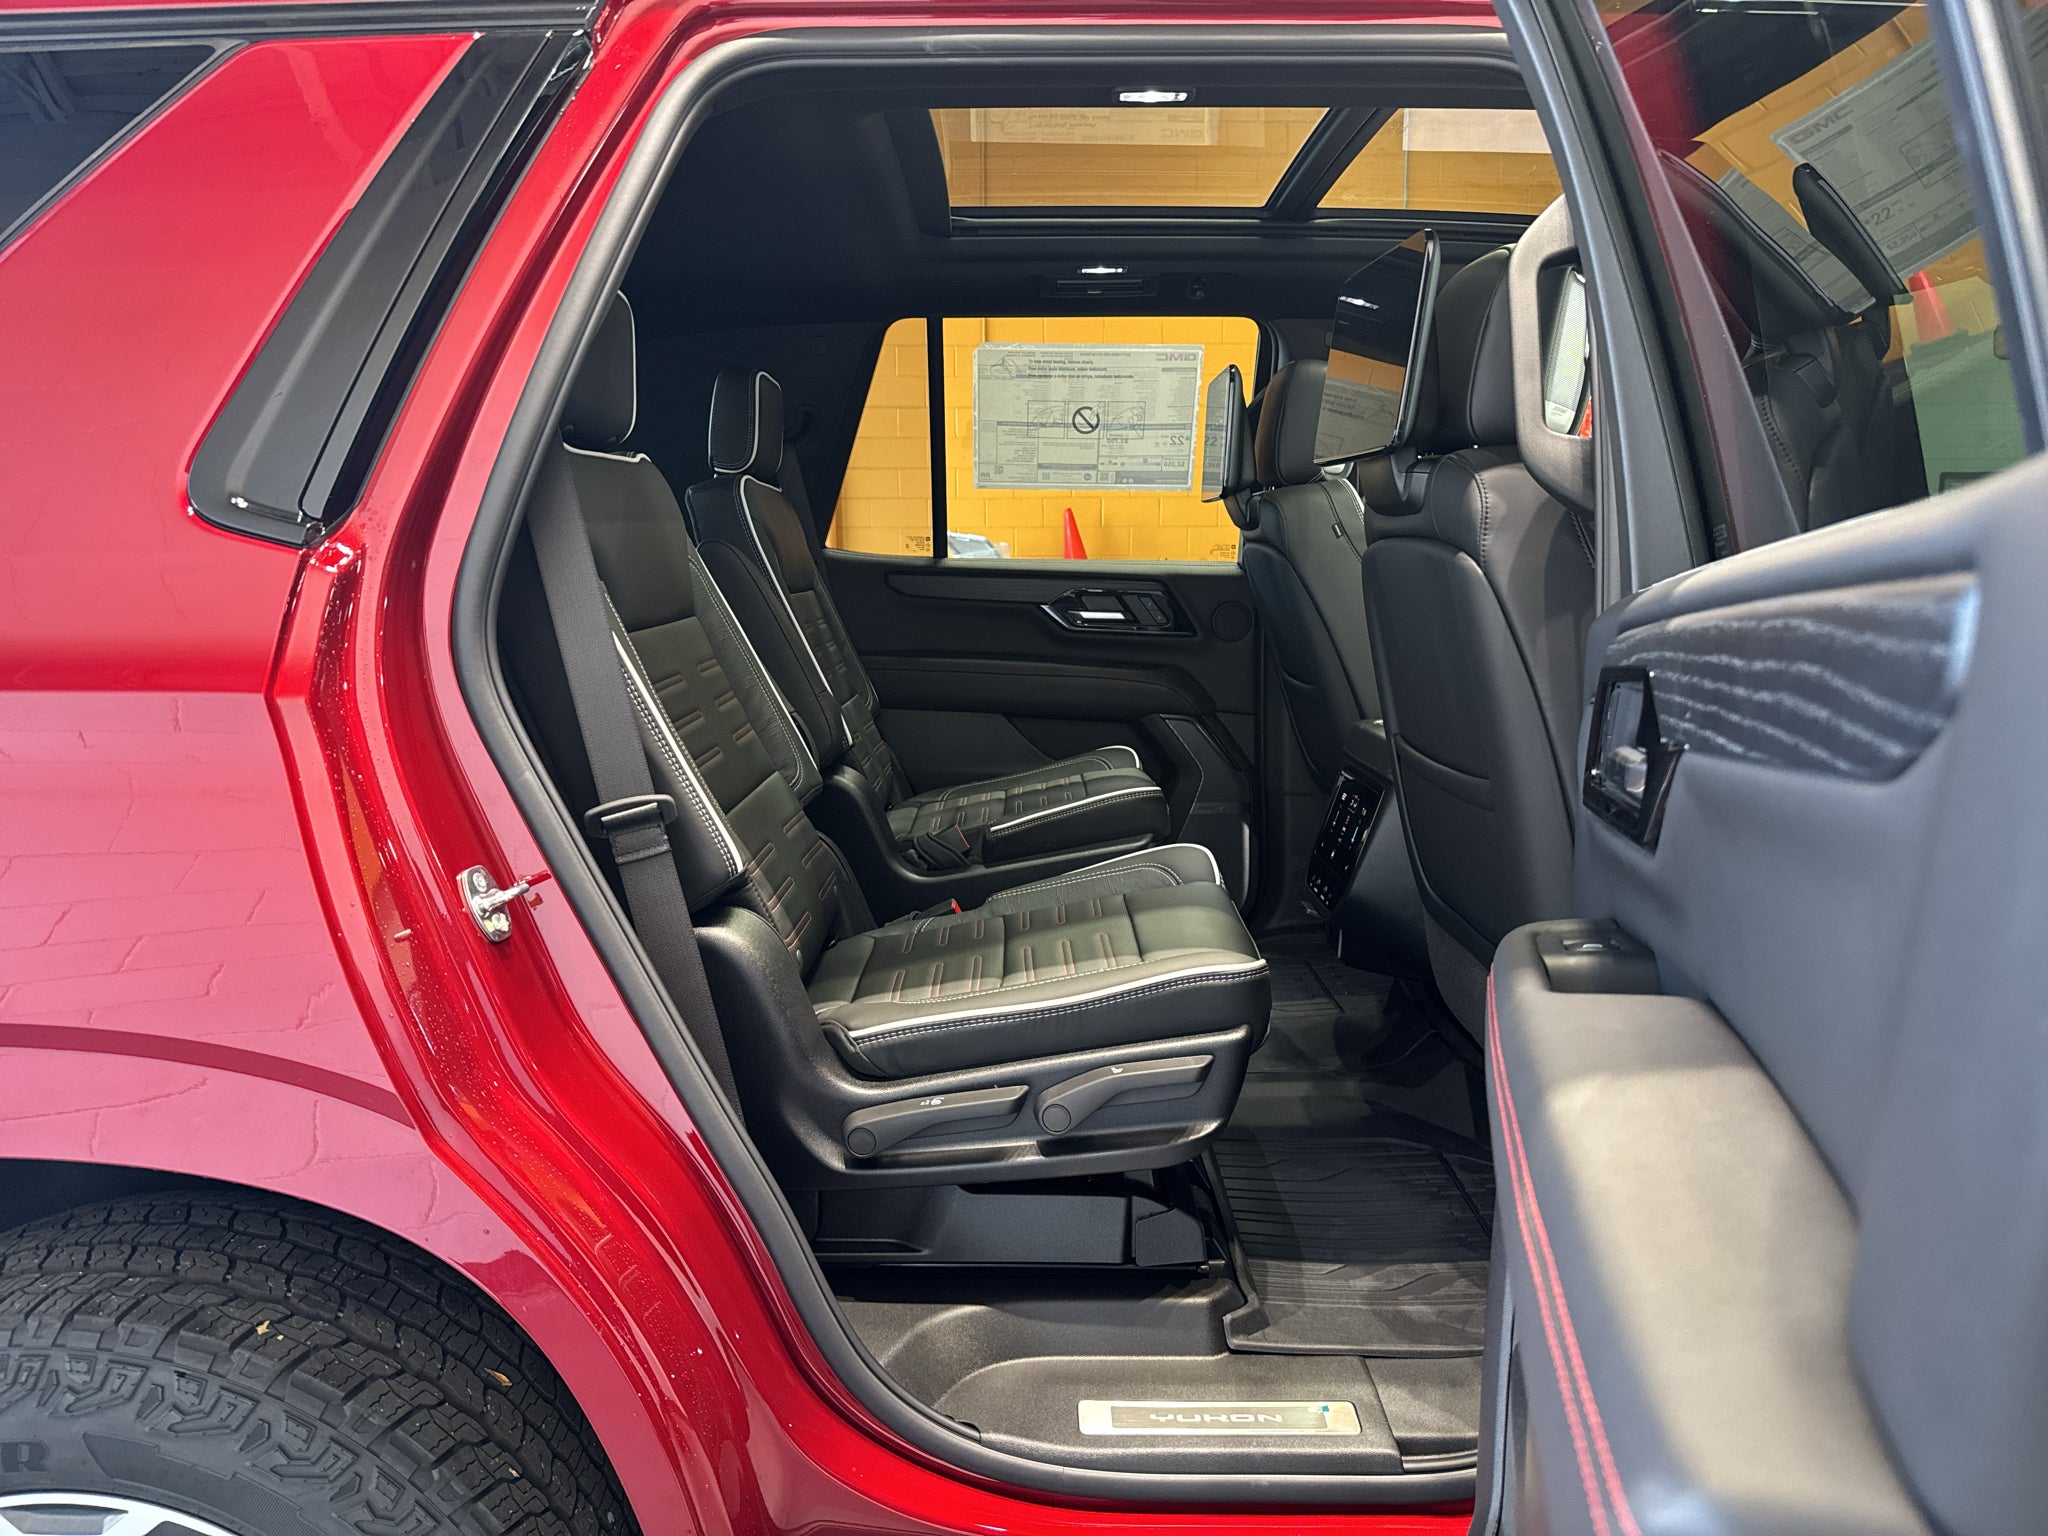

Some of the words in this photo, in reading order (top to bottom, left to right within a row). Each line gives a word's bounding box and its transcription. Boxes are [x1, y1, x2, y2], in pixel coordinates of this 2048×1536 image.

[1789, 103, 1855, 145] GMC
[1869, 206, 1896, 227] 22
[1149, 1413, 1283, 1424] YUKON
[0, 1442, 50, 1473] R
